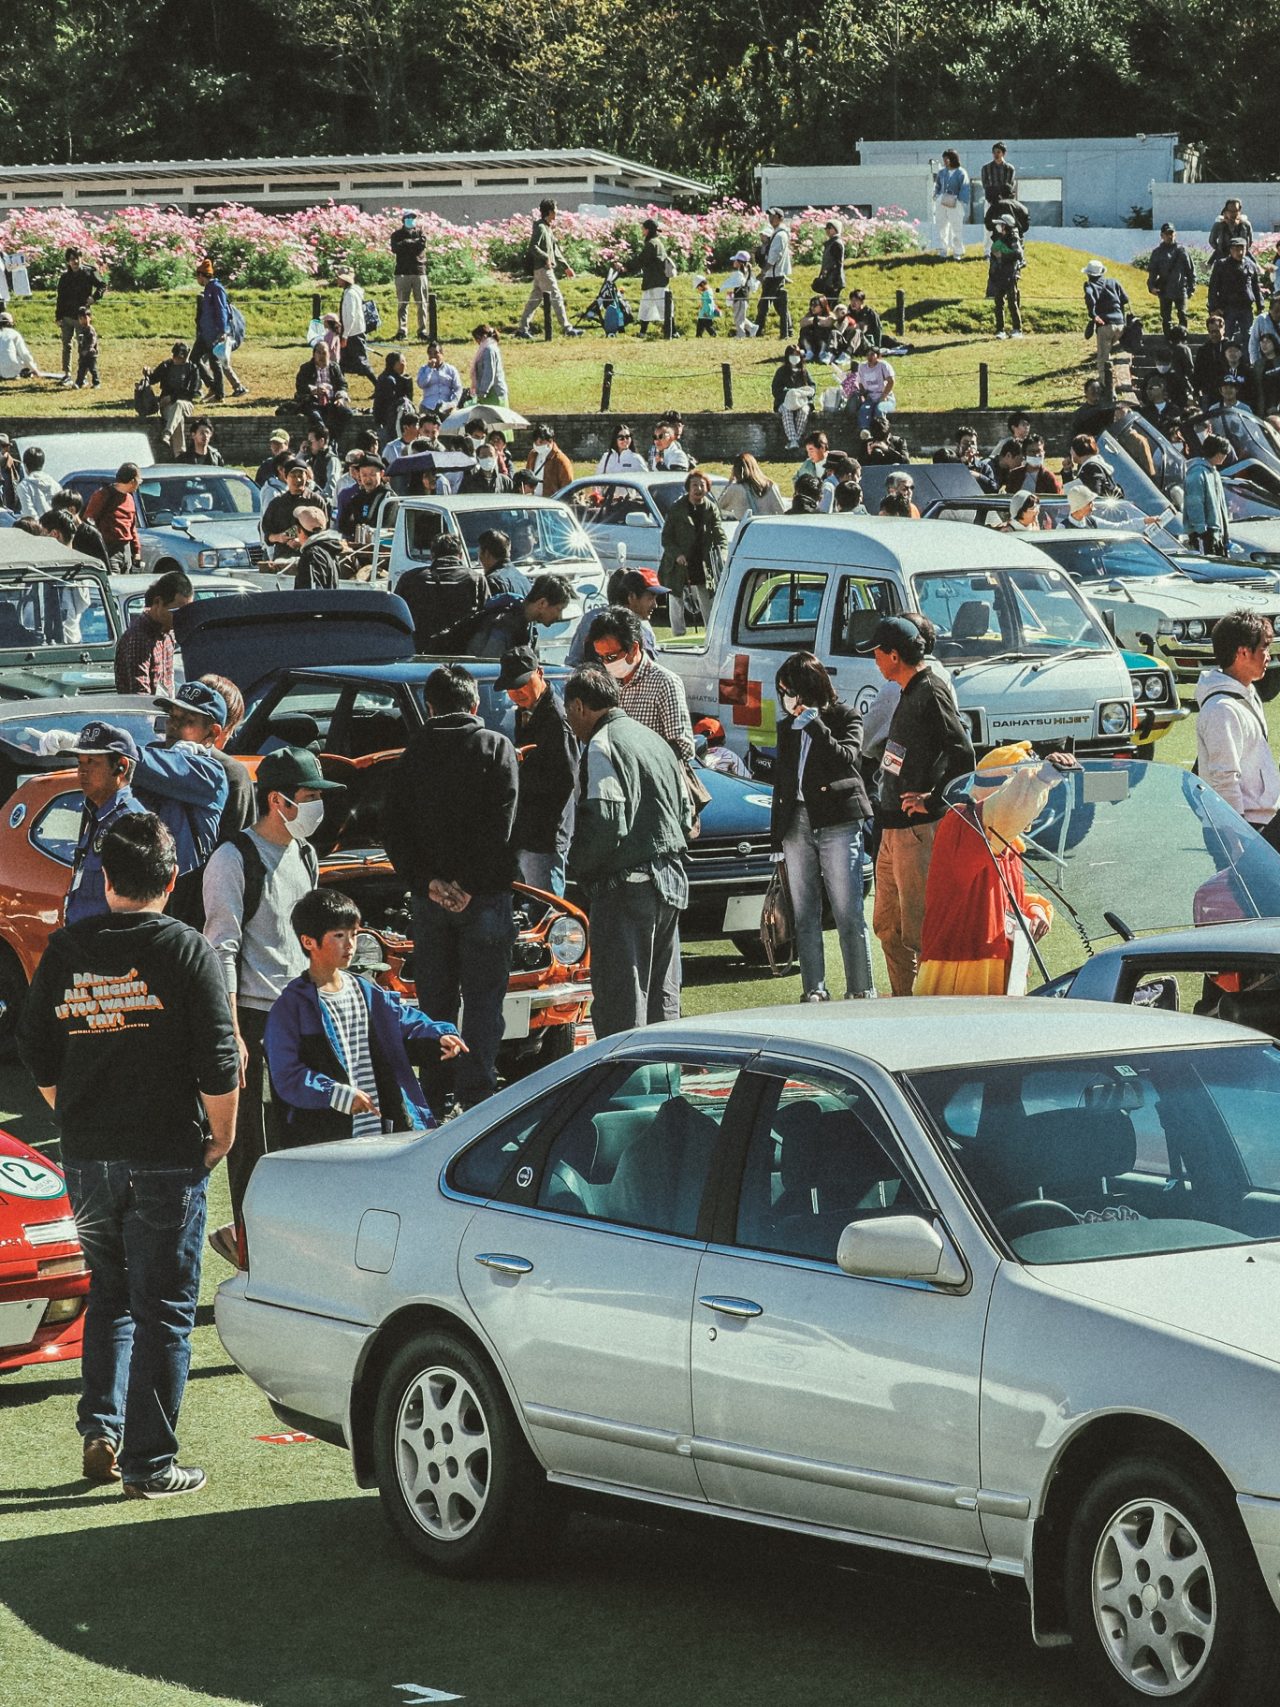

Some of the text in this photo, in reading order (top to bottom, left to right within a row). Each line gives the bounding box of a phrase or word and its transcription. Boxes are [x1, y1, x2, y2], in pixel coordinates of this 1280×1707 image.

[992, 715, 1090, 728] DAIHATSU HIJET
[64, 980, 148, 1003] ALL NIGHT!
[69, 1000, 100, 1017] YOU
[99, 995, 165, 1012] WANNA
[86, 1012, 125, 1029] TRY!
